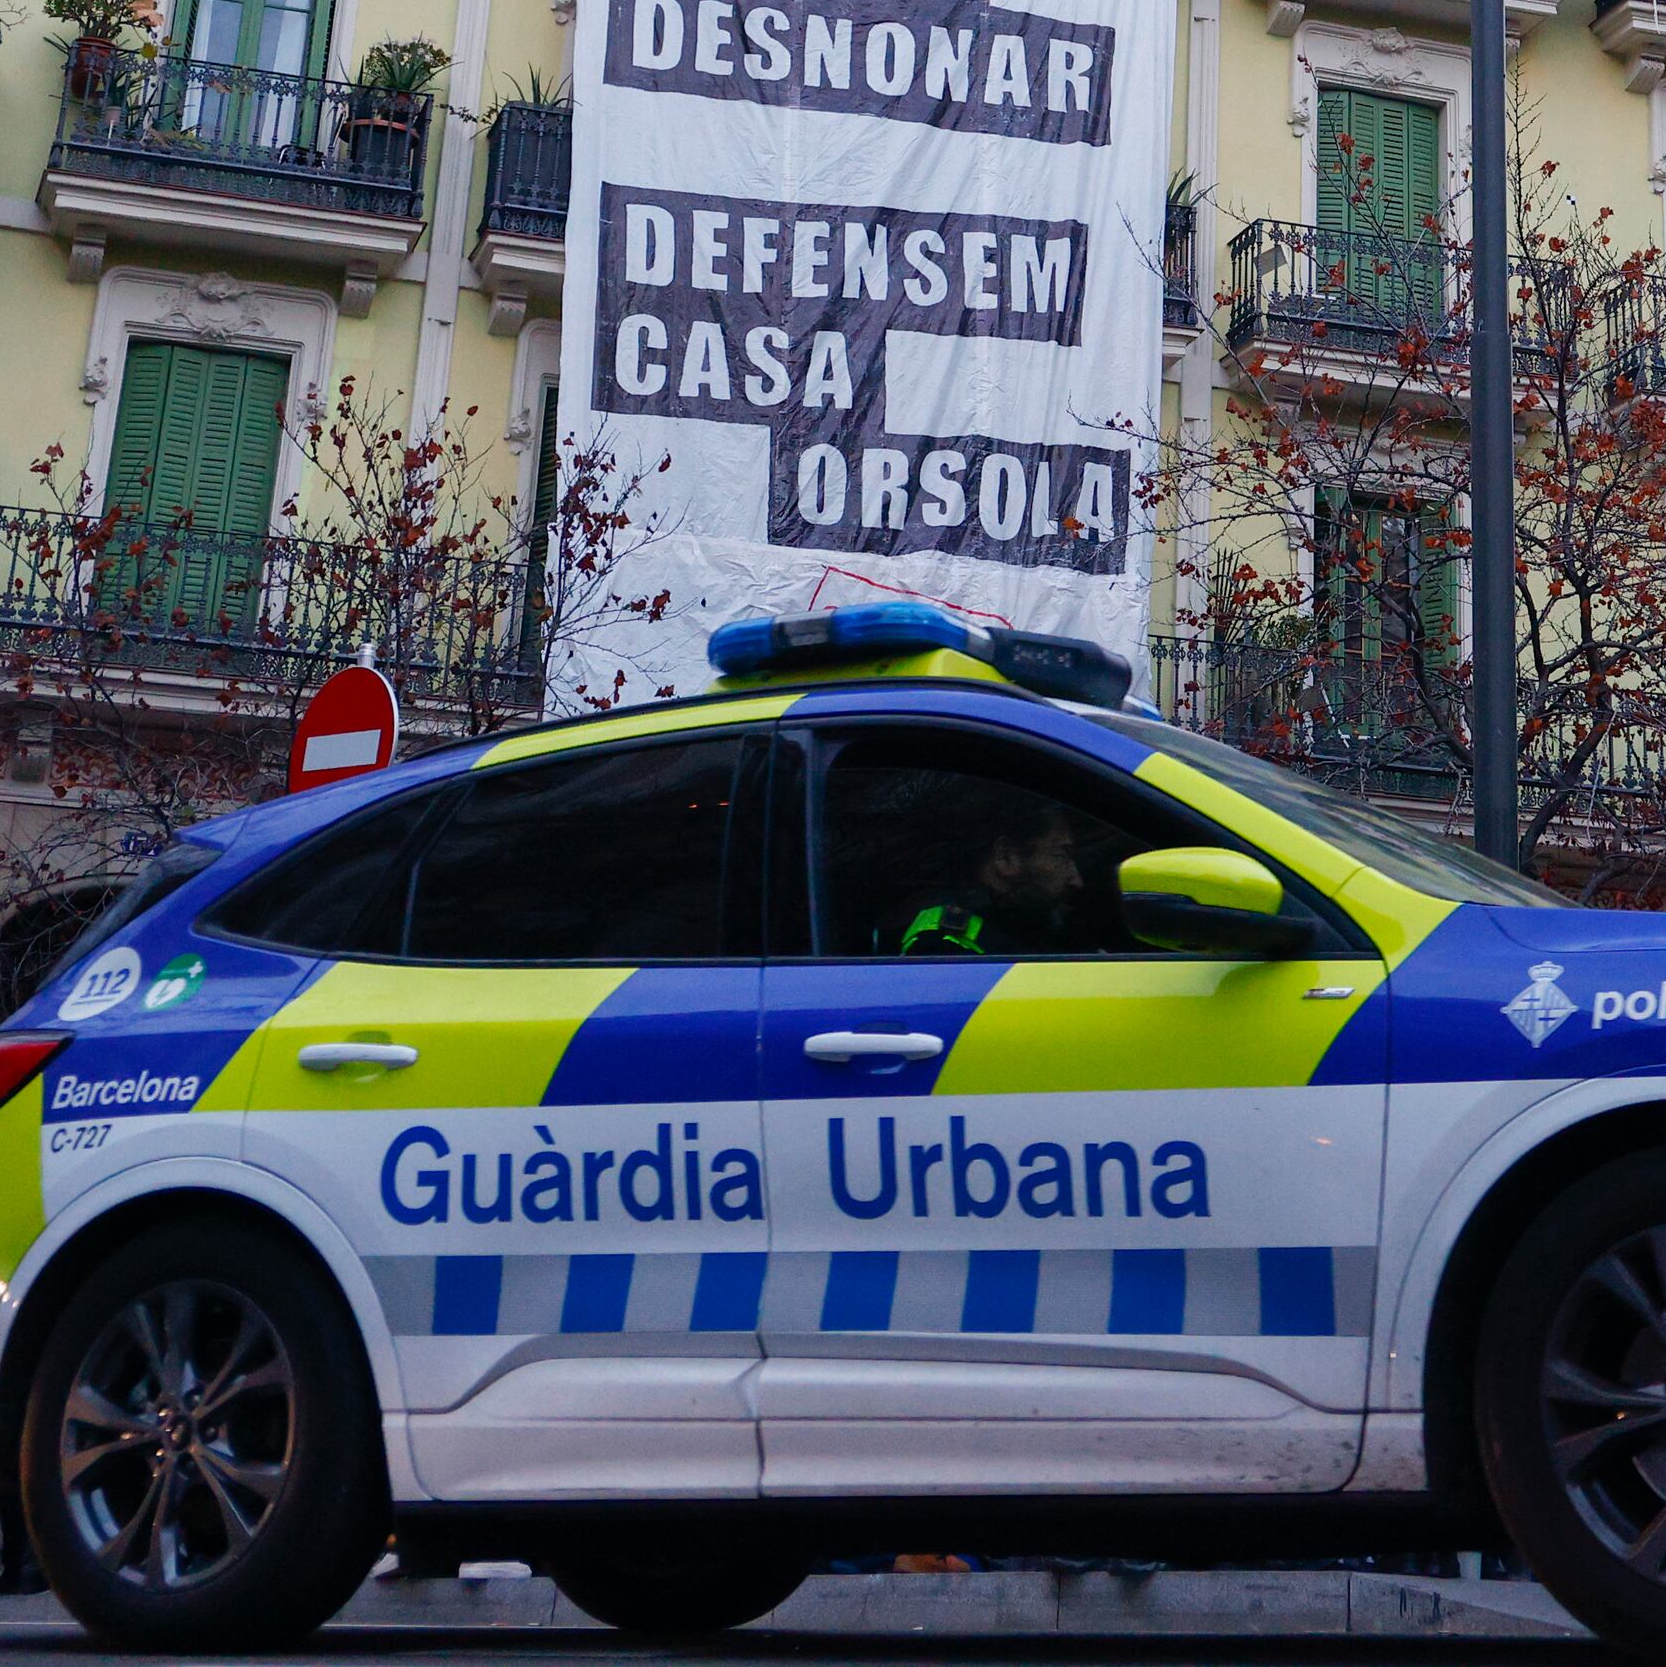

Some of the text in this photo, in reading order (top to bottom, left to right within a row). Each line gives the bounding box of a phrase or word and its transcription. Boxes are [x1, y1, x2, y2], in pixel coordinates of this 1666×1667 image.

[624, 203, 1072, 315] DEFENSEM
[614, 314, 854, 410] CASA
[797, 442, 1117, 543] ORSOLA
[79, 967, 131, 999] 112
[50, 1069, 201, 1111] Barcelona
[50, 1124, 113, 1154] C-727
[380, 1114, 1211, 1227] Guàrdia Urbana
